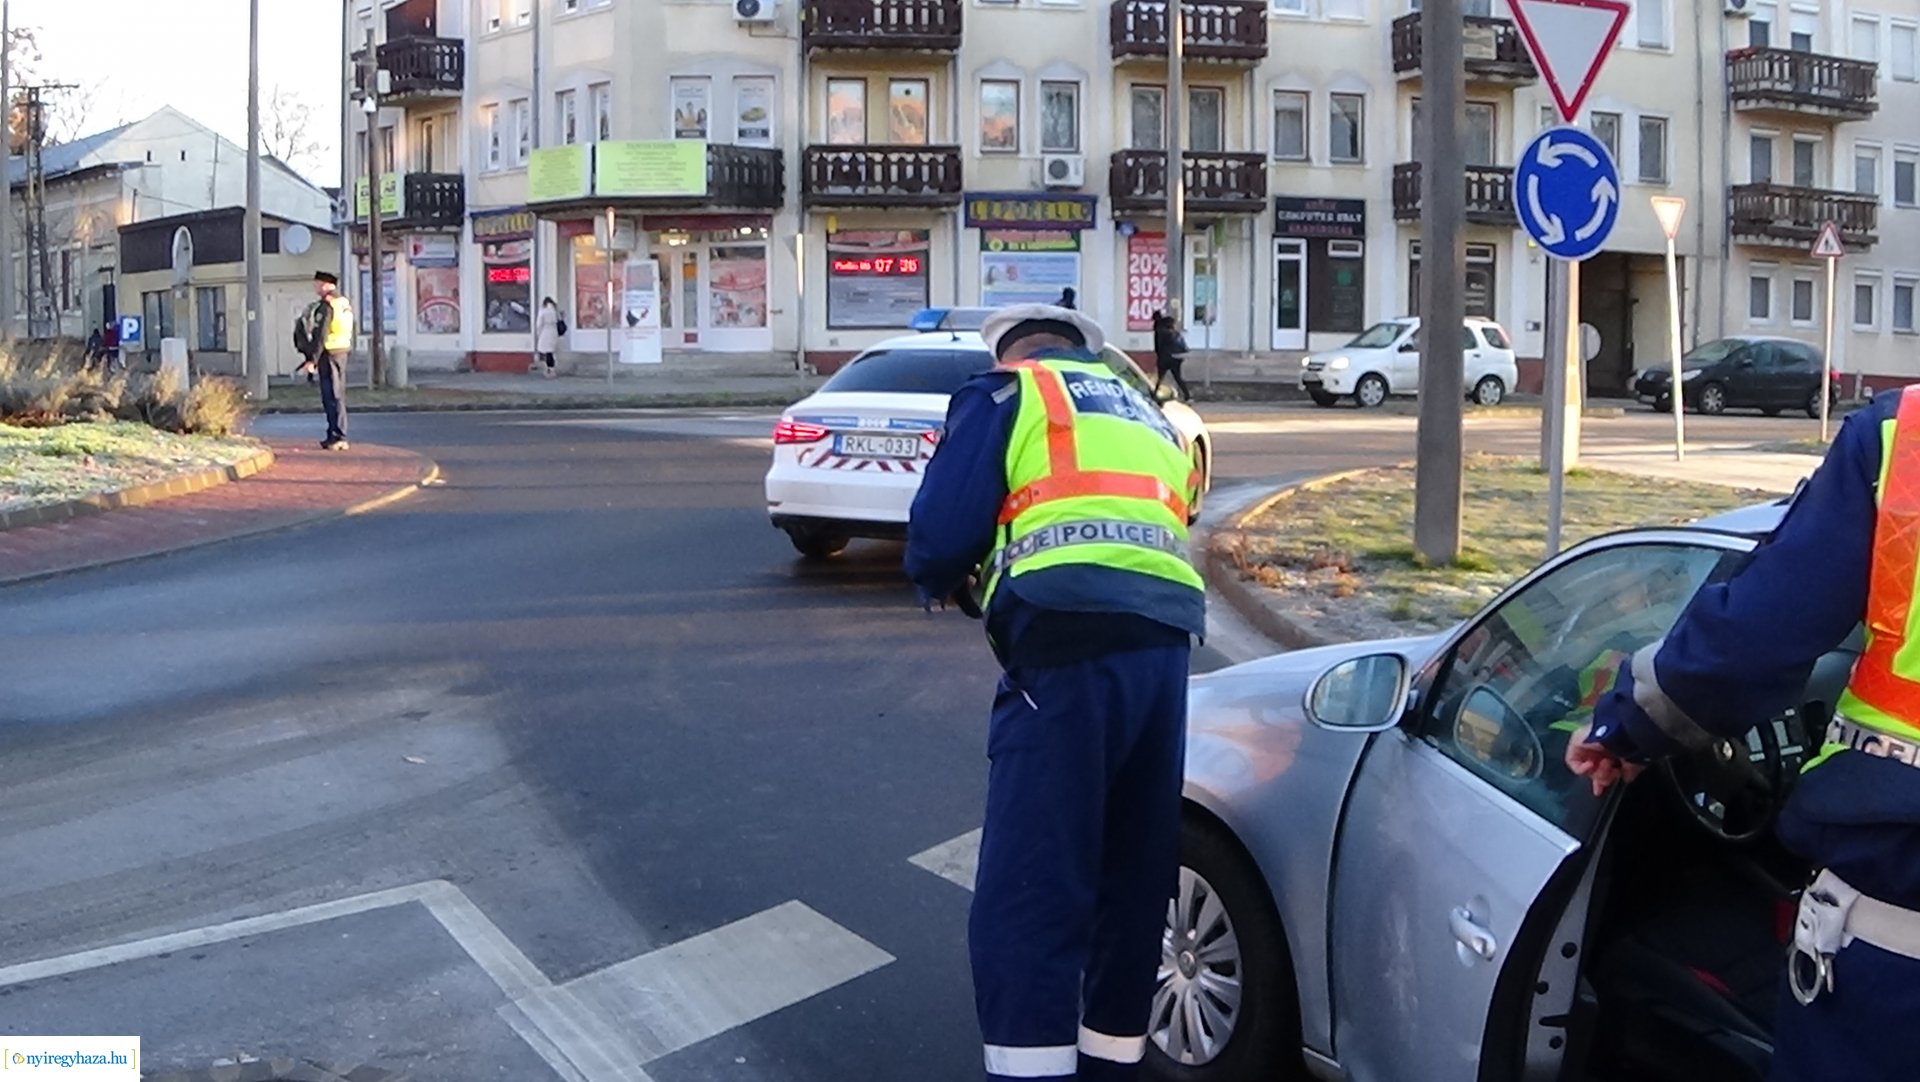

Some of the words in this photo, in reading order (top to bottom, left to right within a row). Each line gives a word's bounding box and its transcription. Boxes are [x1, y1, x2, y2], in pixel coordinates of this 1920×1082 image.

[1129, 253, 1168, 275] 20%
[1129, 275, 1168, 298] 30%
[1129, 298, 1168, 320] 40%
[122, 318, 139, 339] P
[845, 437, 914, 455] RKL-033
[1062, 524, 1154, 544] POLICE
